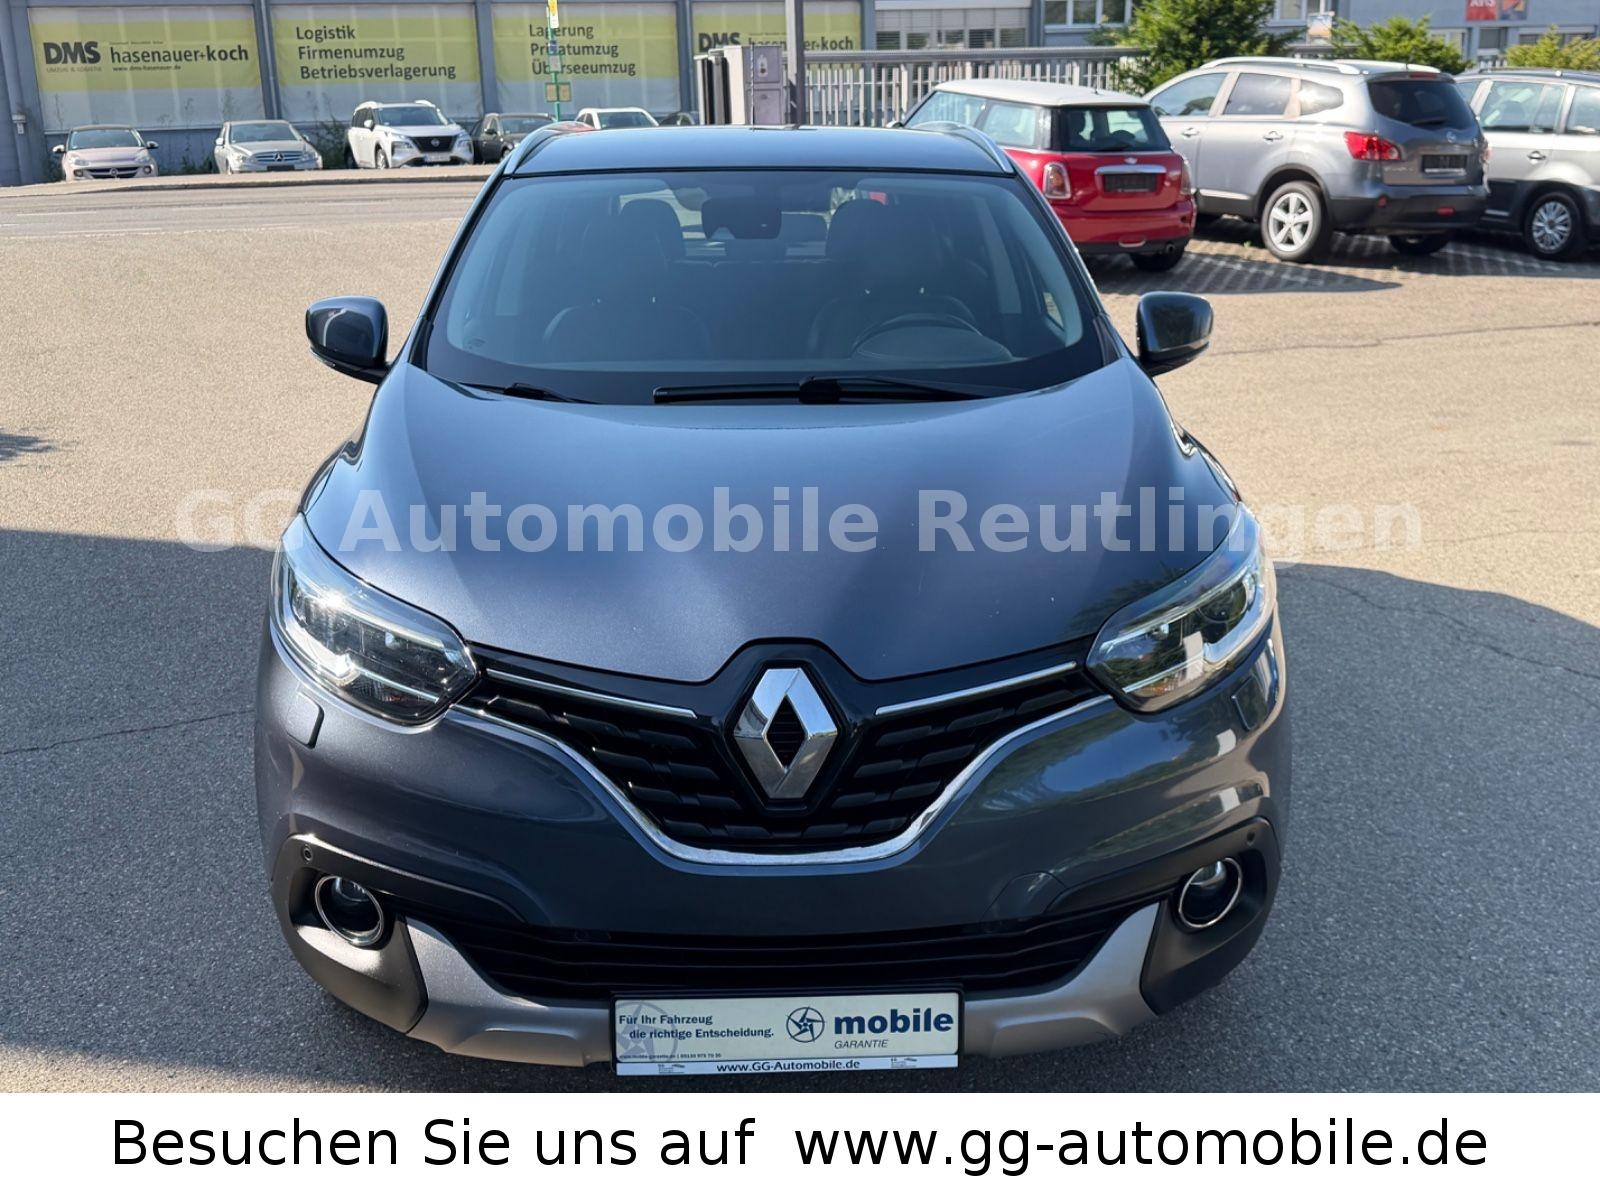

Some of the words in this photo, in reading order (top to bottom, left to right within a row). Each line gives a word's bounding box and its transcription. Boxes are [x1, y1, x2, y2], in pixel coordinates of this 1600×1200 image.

[296, 26, 356, 42] Logistik
[43, 41, 101, 64] DMS
[298, 46, 405, 61] Firmenumzug
[531, 43, 619, 58] Priatumzug
[300, 64, 456, 80] Betriebsverlagerung
[532, 59, 636, 76] Übrseeumzug
[619, 1014, 638, 1025] Für
[641, 1014, 656, 1025] Ihr
[660, 1014, 713, 1026] Fahrzeug
[834, 1007, 954, 1035] mobile
[629, 1029, 647, 1039] die
[650, 1028, 692, 1040] richtige
[695, 1027, 774, 1039] Entscheidung.
[834, 1039, 889, 1050] GARANTIE
[716, 1059, 861, 1072] www.GG-Automobile.de
